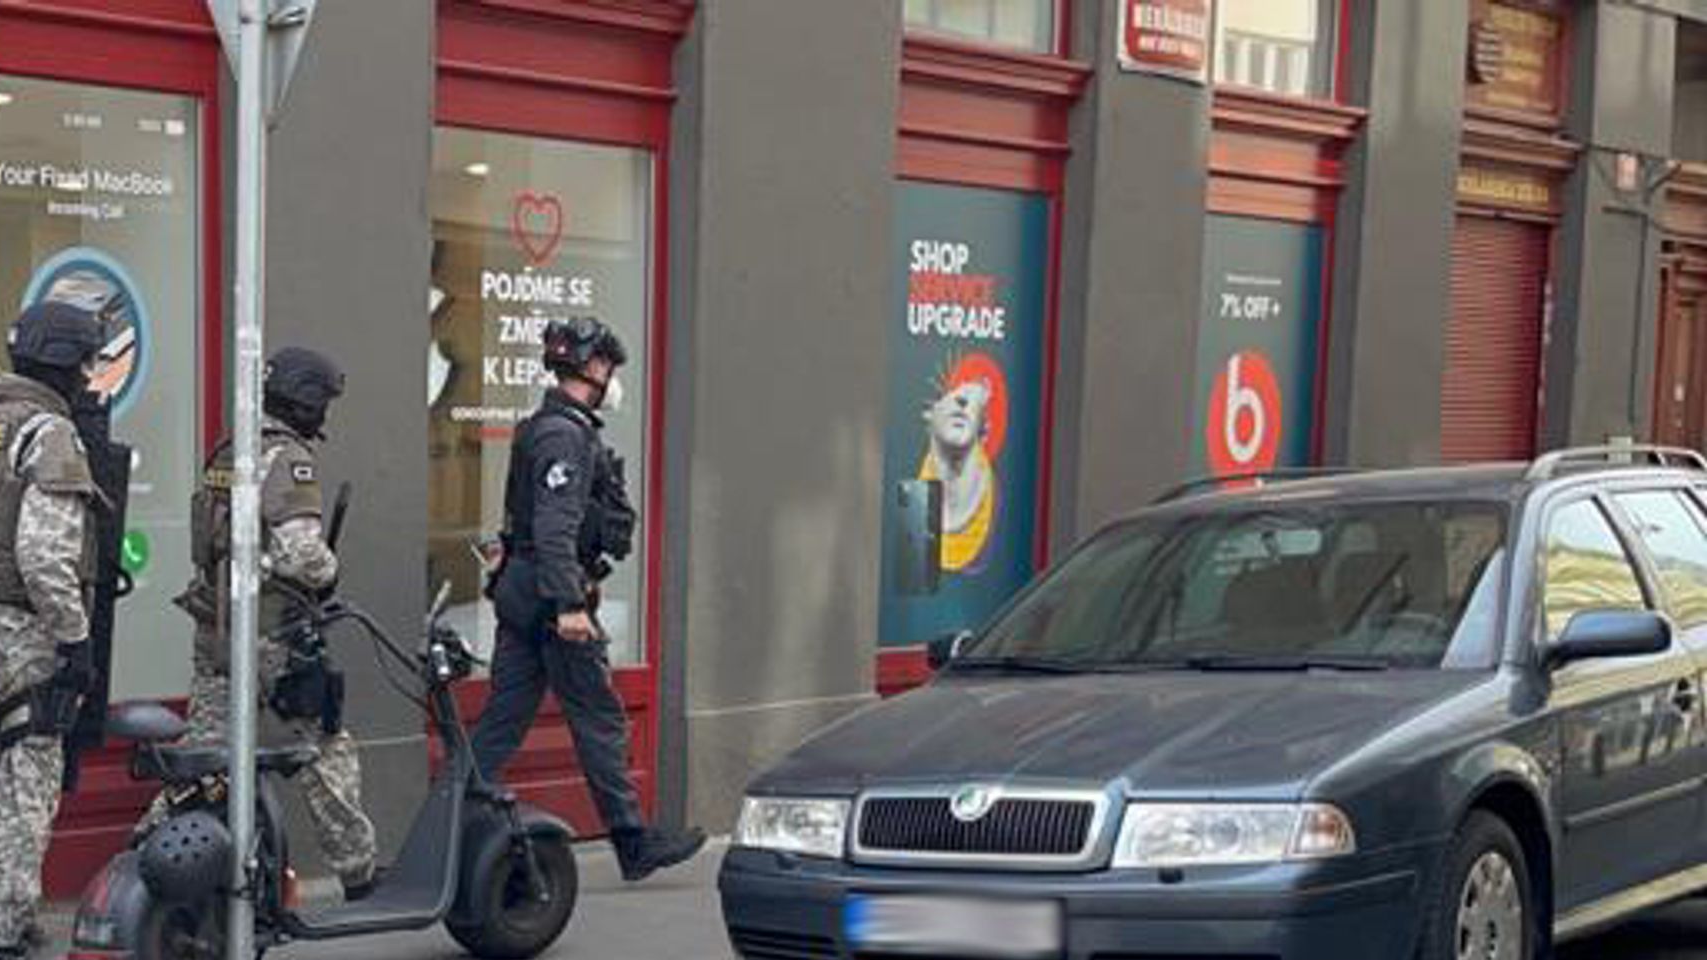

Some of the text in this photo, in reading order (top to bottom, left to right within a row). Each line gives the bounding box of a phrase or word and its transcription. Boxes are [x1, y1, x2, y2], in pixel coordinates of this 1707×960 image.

[910, 240, 969, 274] SHOP
[567, 278, 593, 306] SE
[907, 302, 1005, 339] UPGRADE
[483, 357, 500, 385] K
